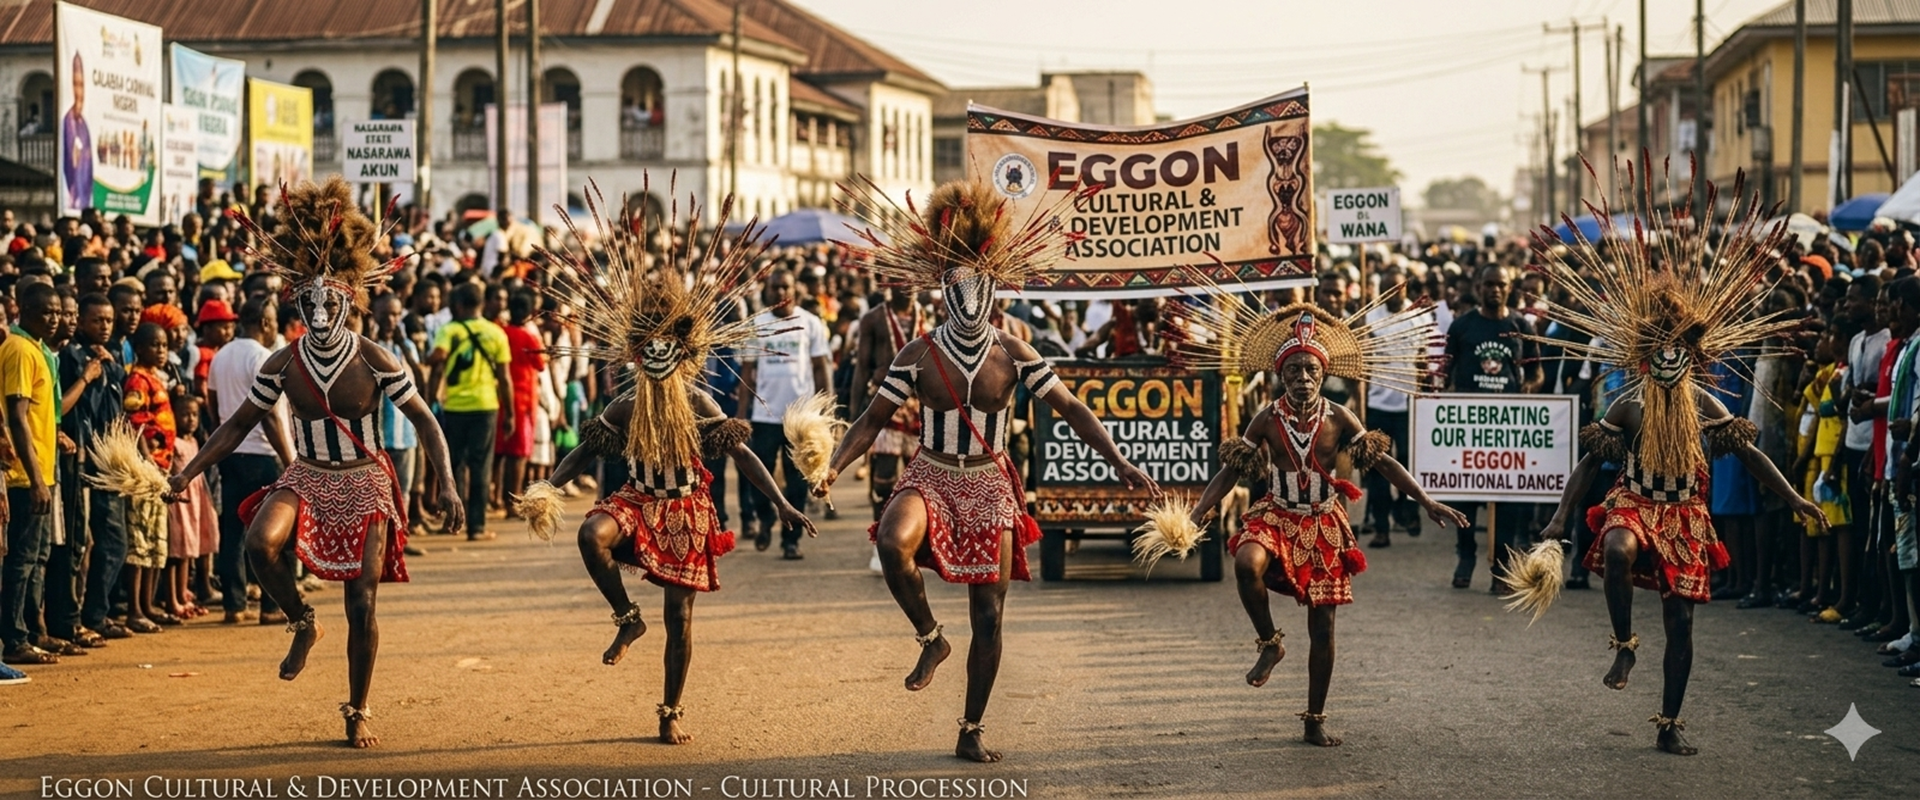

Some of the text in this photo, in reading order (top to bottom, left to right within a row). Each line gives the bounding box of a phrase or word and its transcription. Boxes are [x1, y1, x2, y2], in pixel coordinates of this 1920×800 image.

[347, 147, 411, 159] NASARAWA
[360, 163, 399, 177] AKUN
[1048, 141, 1240, 191] EGGON
[1073, 187, 1216, 214] CULTURAL &
[1334, 192, 1389, 210] EGGON
[1071, 207, 1244, 236] DEVELOPMENT
[1340, 222, 1388, 238] WANA
[1065, 232, 1221, 258] ASSOCIATION
[1435, 405, 1550, 426] CELEBRATING
[1189, 420, 1210, 440] &
[1431, 428, 1554, 448] OUR HERITAGE
[1045, 442, 1212, 460] DEVEOPMENT
[1462, 451, 1525, 470] EGGON
[1420, 472, 1564, 490] TRADITIONAL DANCE
